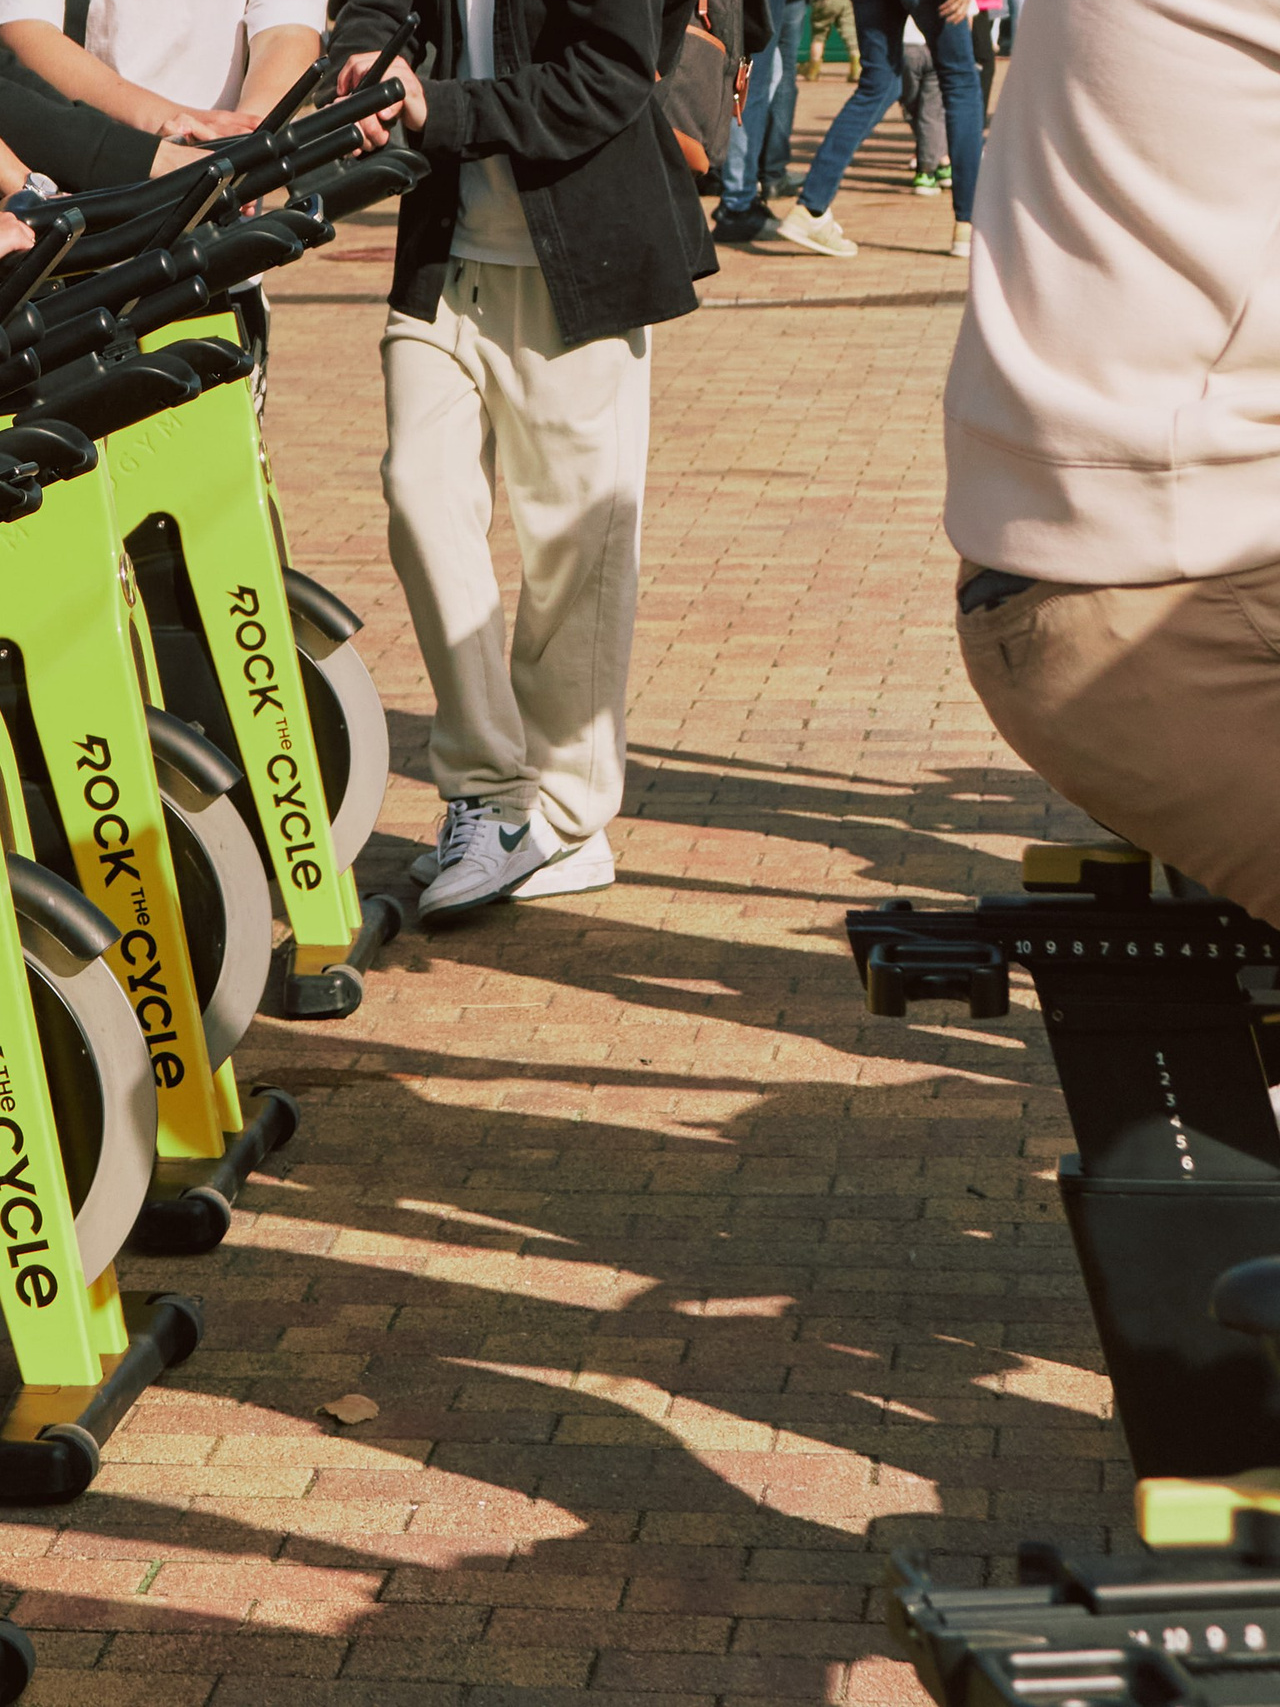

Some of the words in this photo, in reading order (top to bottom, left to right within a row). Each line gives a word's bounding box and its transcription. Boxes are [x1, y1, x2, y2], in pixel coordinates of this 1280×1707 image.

[226, 585, 283, 716] ROCK
[73, 734, 141, 888] ROCK
[1016, 940, 1032, 954] 10
[1046, 940, 1057, 954] 9
[1072, 941, 1084, 955] 8
[1100, 941, 1110, 955] 7
[1127, 942, 1138, 956] 6
[1154, 943, 1164, 956] 5
[1181, 943, 1192, 956] 4
[1208, 944, 1218, 958] 3
[1235, 944, 1246, 958] 2
[1263, 944, 1272, 958] 1
[1155, 1051, 1165, 1066] 1
[1160, 1071, 1171, 1086] 2
[1165, 1092, 1176, 1107] 3
[1169, 1114, 1182, 1129] 4
[1175, 1133, 1188, 1150] 5
[1180, 1155, 1195, 1171] 6
